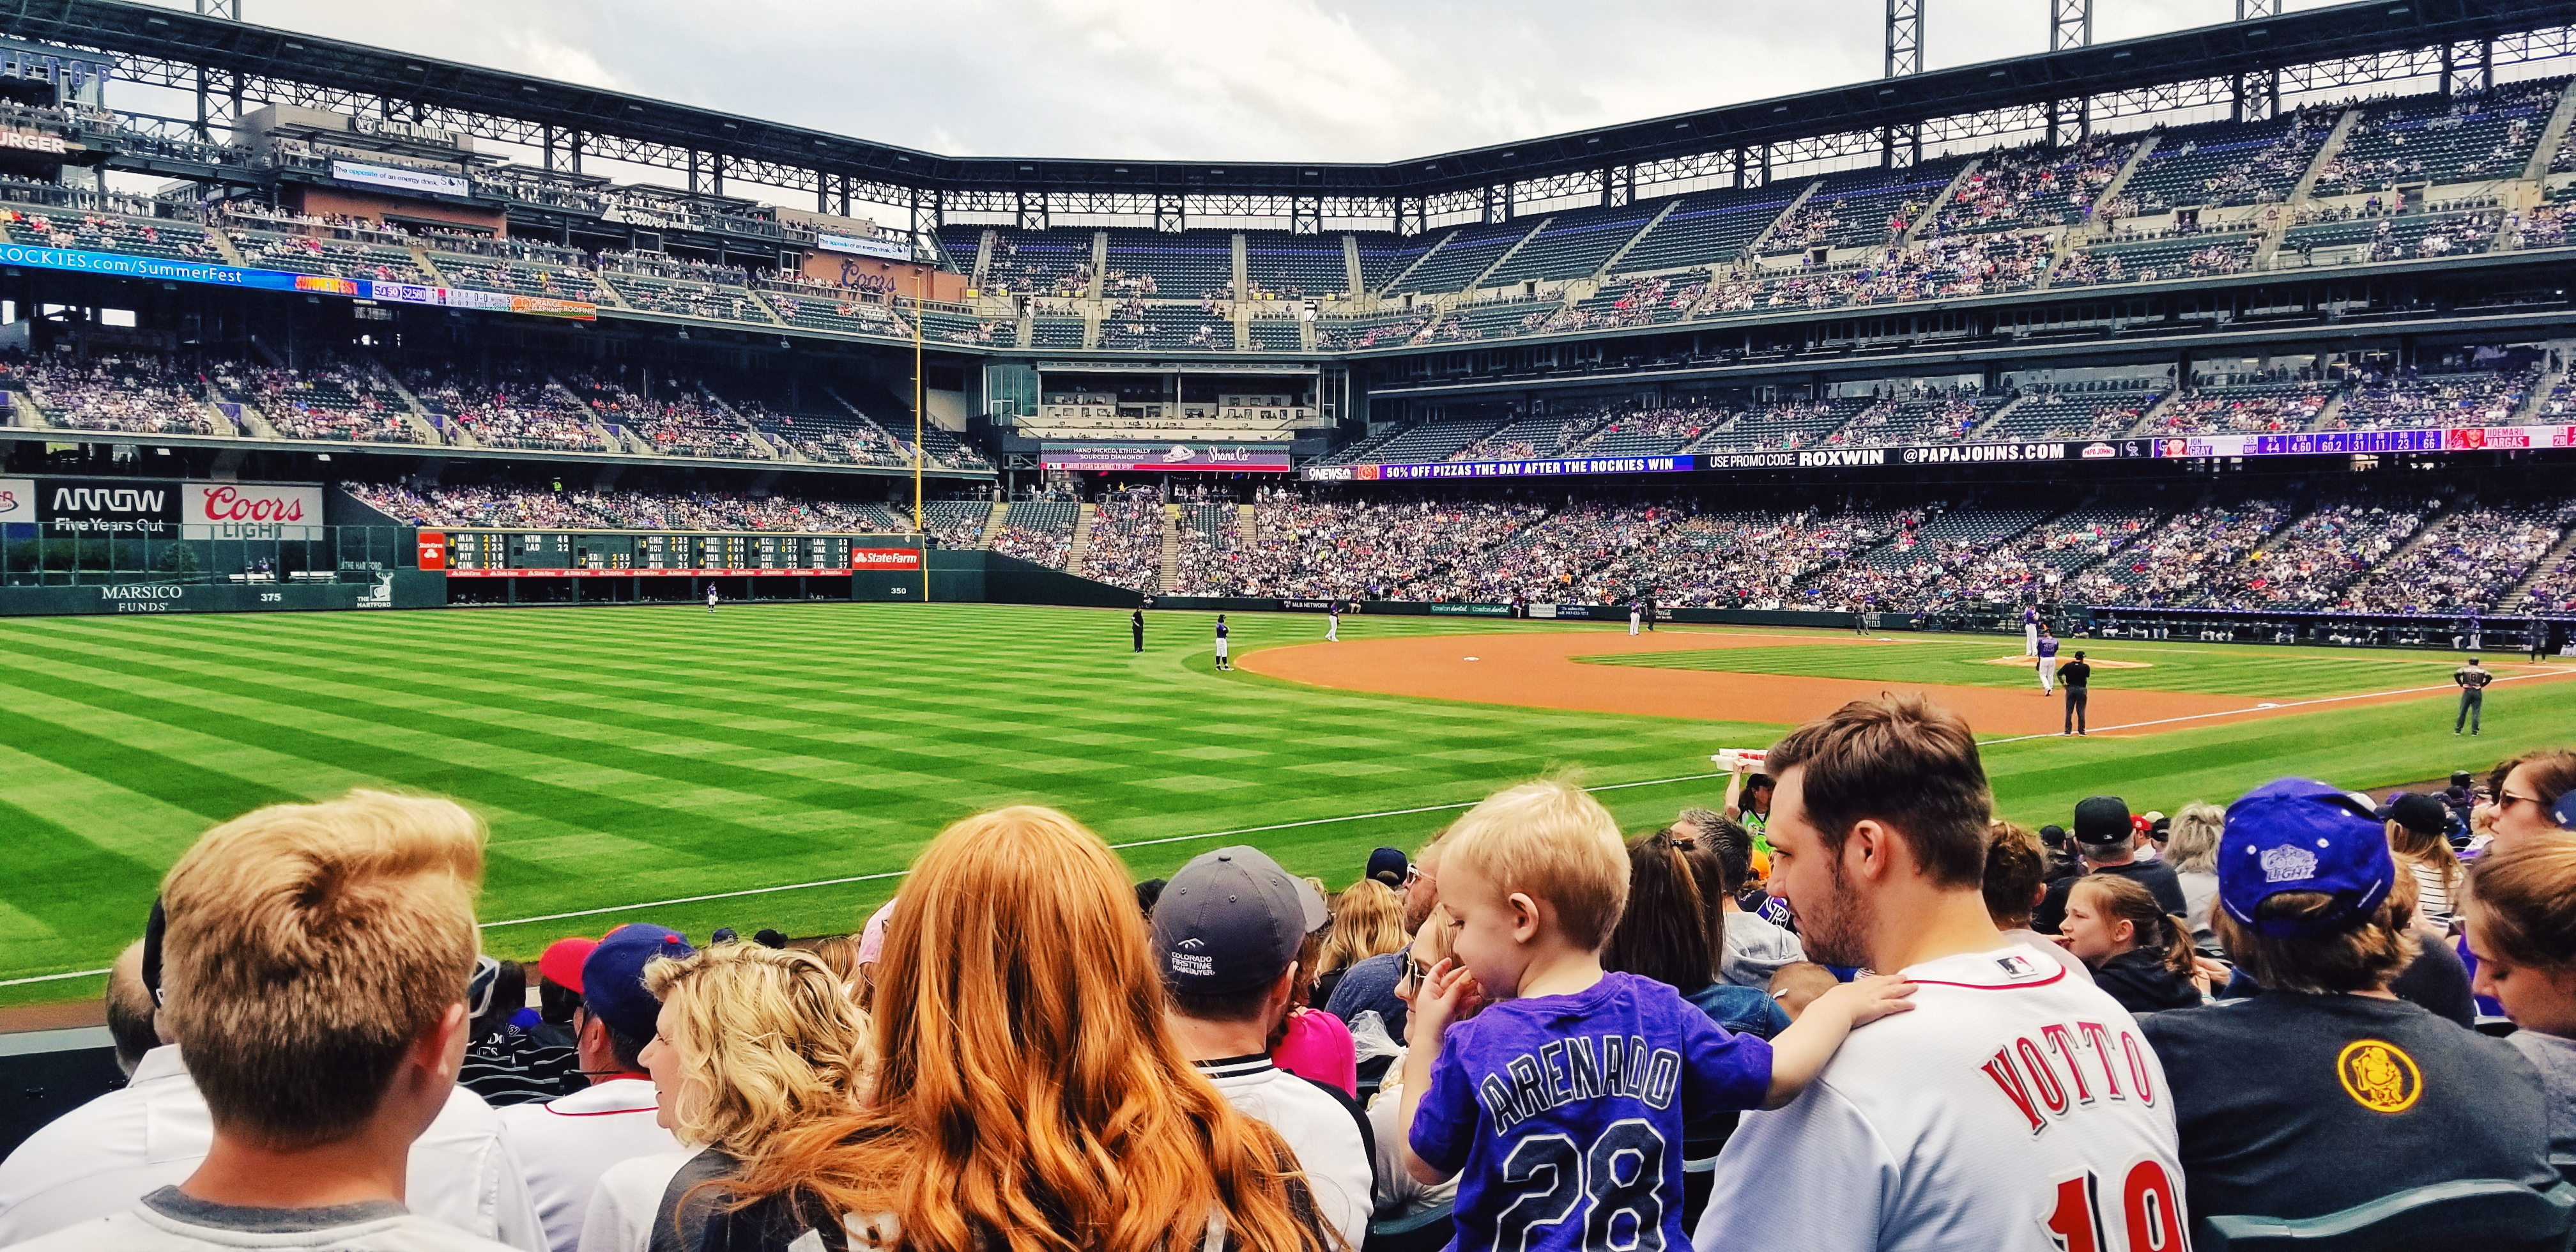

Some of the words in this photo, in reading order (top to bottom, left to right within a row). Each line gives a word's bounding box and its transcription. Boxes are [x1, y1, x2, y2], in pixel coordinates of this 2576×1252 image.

[378, 117, 408, 136] JACK
[348, 169, 378, 178] opposite
[626, 210, 668, 228] Silver
[841, 263, 896, 293] Coors
[295, 275, 358, 295] SUMMERFEST
[531, 298, 562, 307] ORANGE
[564, 305, 595, 314] ROOFING
[2292, 442, 2311, 452] 4.60
[2322, 442, 2342, 451] 60.2
[2354, 440, 2364, 450] 31
[2375, 440, 2385, 450] 11
[2398, 439, 2409, 449] 23
[2423, 438, 2434, 449] 66
[2487, 437, 2524, 447] VARGAS
[1208, 446, 1234, 463] Shane
[1903, 444, 2064, 463] @PAPAJOHNS.COM
[2189, 446, 2210, 455] GRAY
[1710, 456, 1729, 468] USE
[1731, 454, 1765, 467] PROMO
[1767, 453, 1795, 466] CODE:
[1799, 449, 1884, 467] ROXWIN
[1386, 467, 1408, 477] 50%
[1411, 466, 1430, 477] OFF
[1433, 465, 1471, 476] PIZZAS
[1475, 464, 1496, 475] THE
[1499, 463, 1521, 474] DAY
[1524, 462, 1560, 474] AFTER
[1564, 461, 1588, 473] THE
[1590, 459, 1644, 472] ROCKIES
[1648, 458, 1673, 470] WIN
[1309, 468, 1342, 480] 9NEWS
[54, 488, 164, 511] ARROW
[204, 486, 303, 522] Coors
[56, 518, 89, 530] Five
[89, 518, 133, 531] Years
[137, 518, 164, 532] Out
[224, 522, 286, 538] LIGHT
[356, 562, 382, 570] HARFORD
[102, 586, 182, 599] MARSICO
[261, 593, 281, 601] 375
[2268, 869, 2313, 881] LIGHT
[1171, 952, 1213, 962] COLORADO
[1981, 1021, 2156, 1138] VOTTO
[1480, 1035, 1680, 1137] ARENADO
[1492, 1118, 1667, 1252] 28
